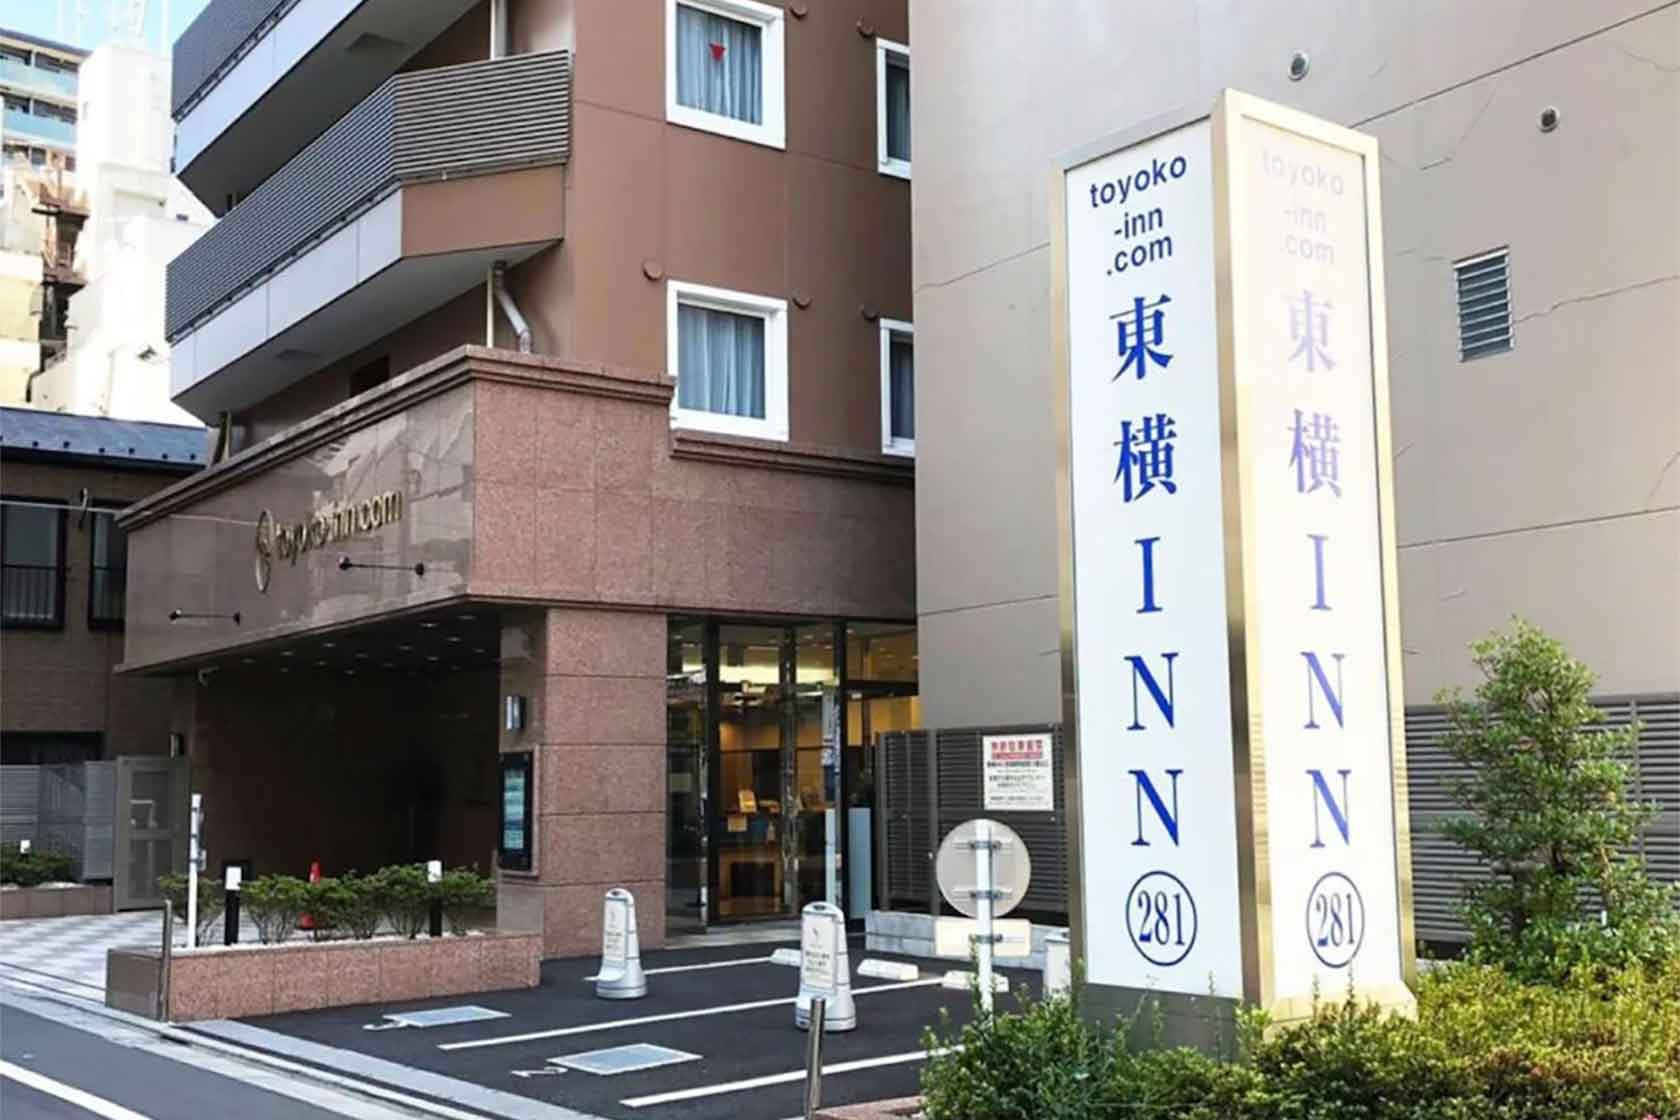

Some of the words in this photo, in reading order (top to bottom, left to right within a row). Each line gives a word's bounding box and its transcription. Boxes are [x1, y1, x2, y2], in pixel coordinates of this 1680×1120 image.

[1090, 153, 1187, 209] toyoko
[1261, 145, 1345, 197] toyoko
[1113, 205, 1164, 241] -inn
[1105, 232, 1173, 276] .com
[1137, 888, 1186, 946] 281
[1315, 891, 1355, 948] 281
